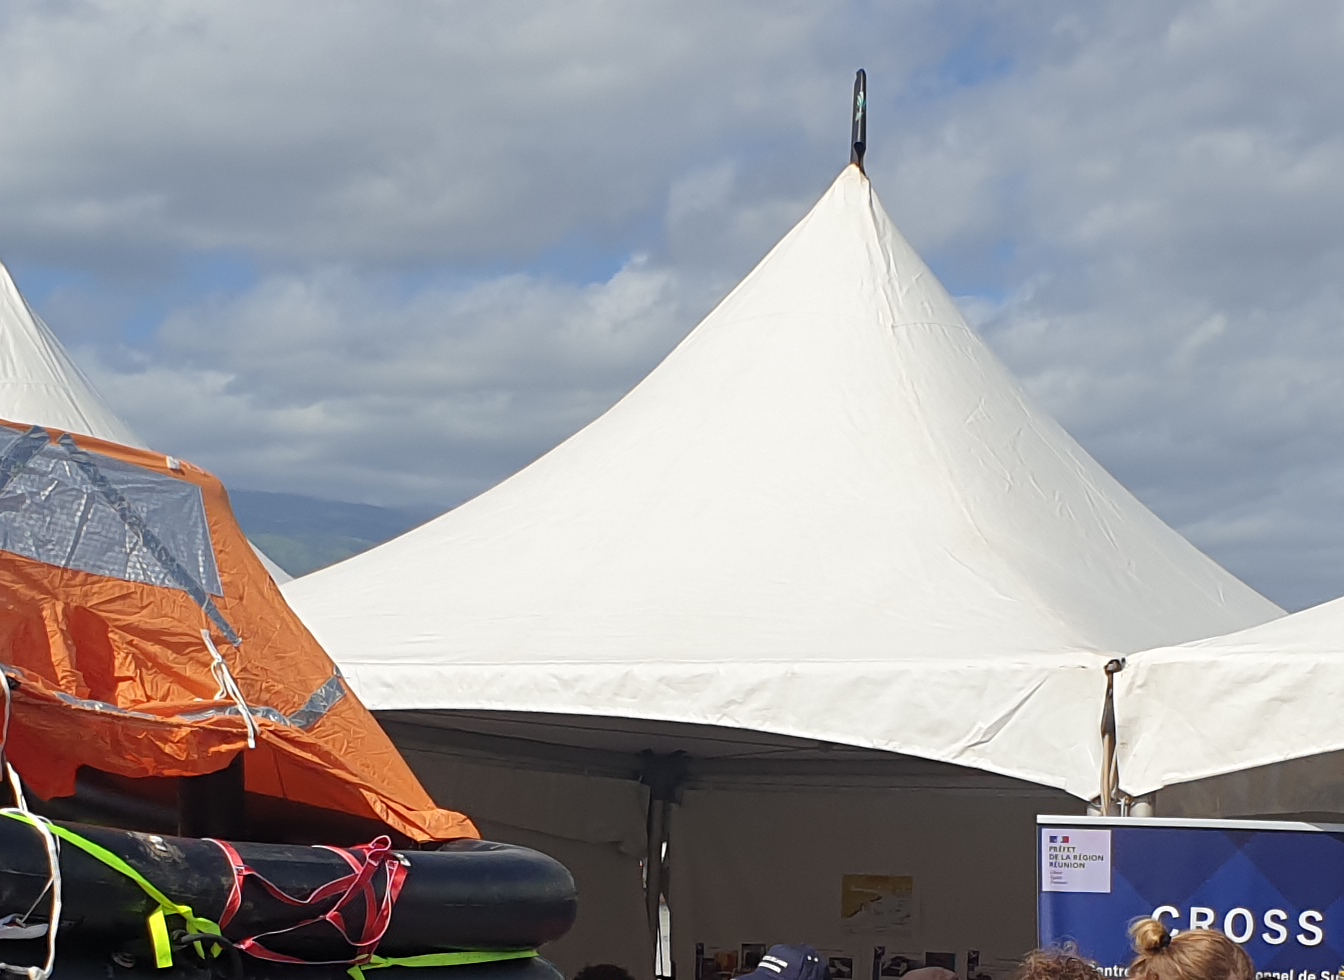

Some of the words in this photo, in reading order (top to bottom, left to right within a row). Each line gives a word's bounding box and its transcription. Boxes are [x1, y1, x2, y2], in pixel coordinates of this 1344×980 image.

[1073, 853, 1104, 861] RÉGION
[1049, 861, 1085, 869] RÉUNION
[1151, 905, 1324, 947] CROSS
